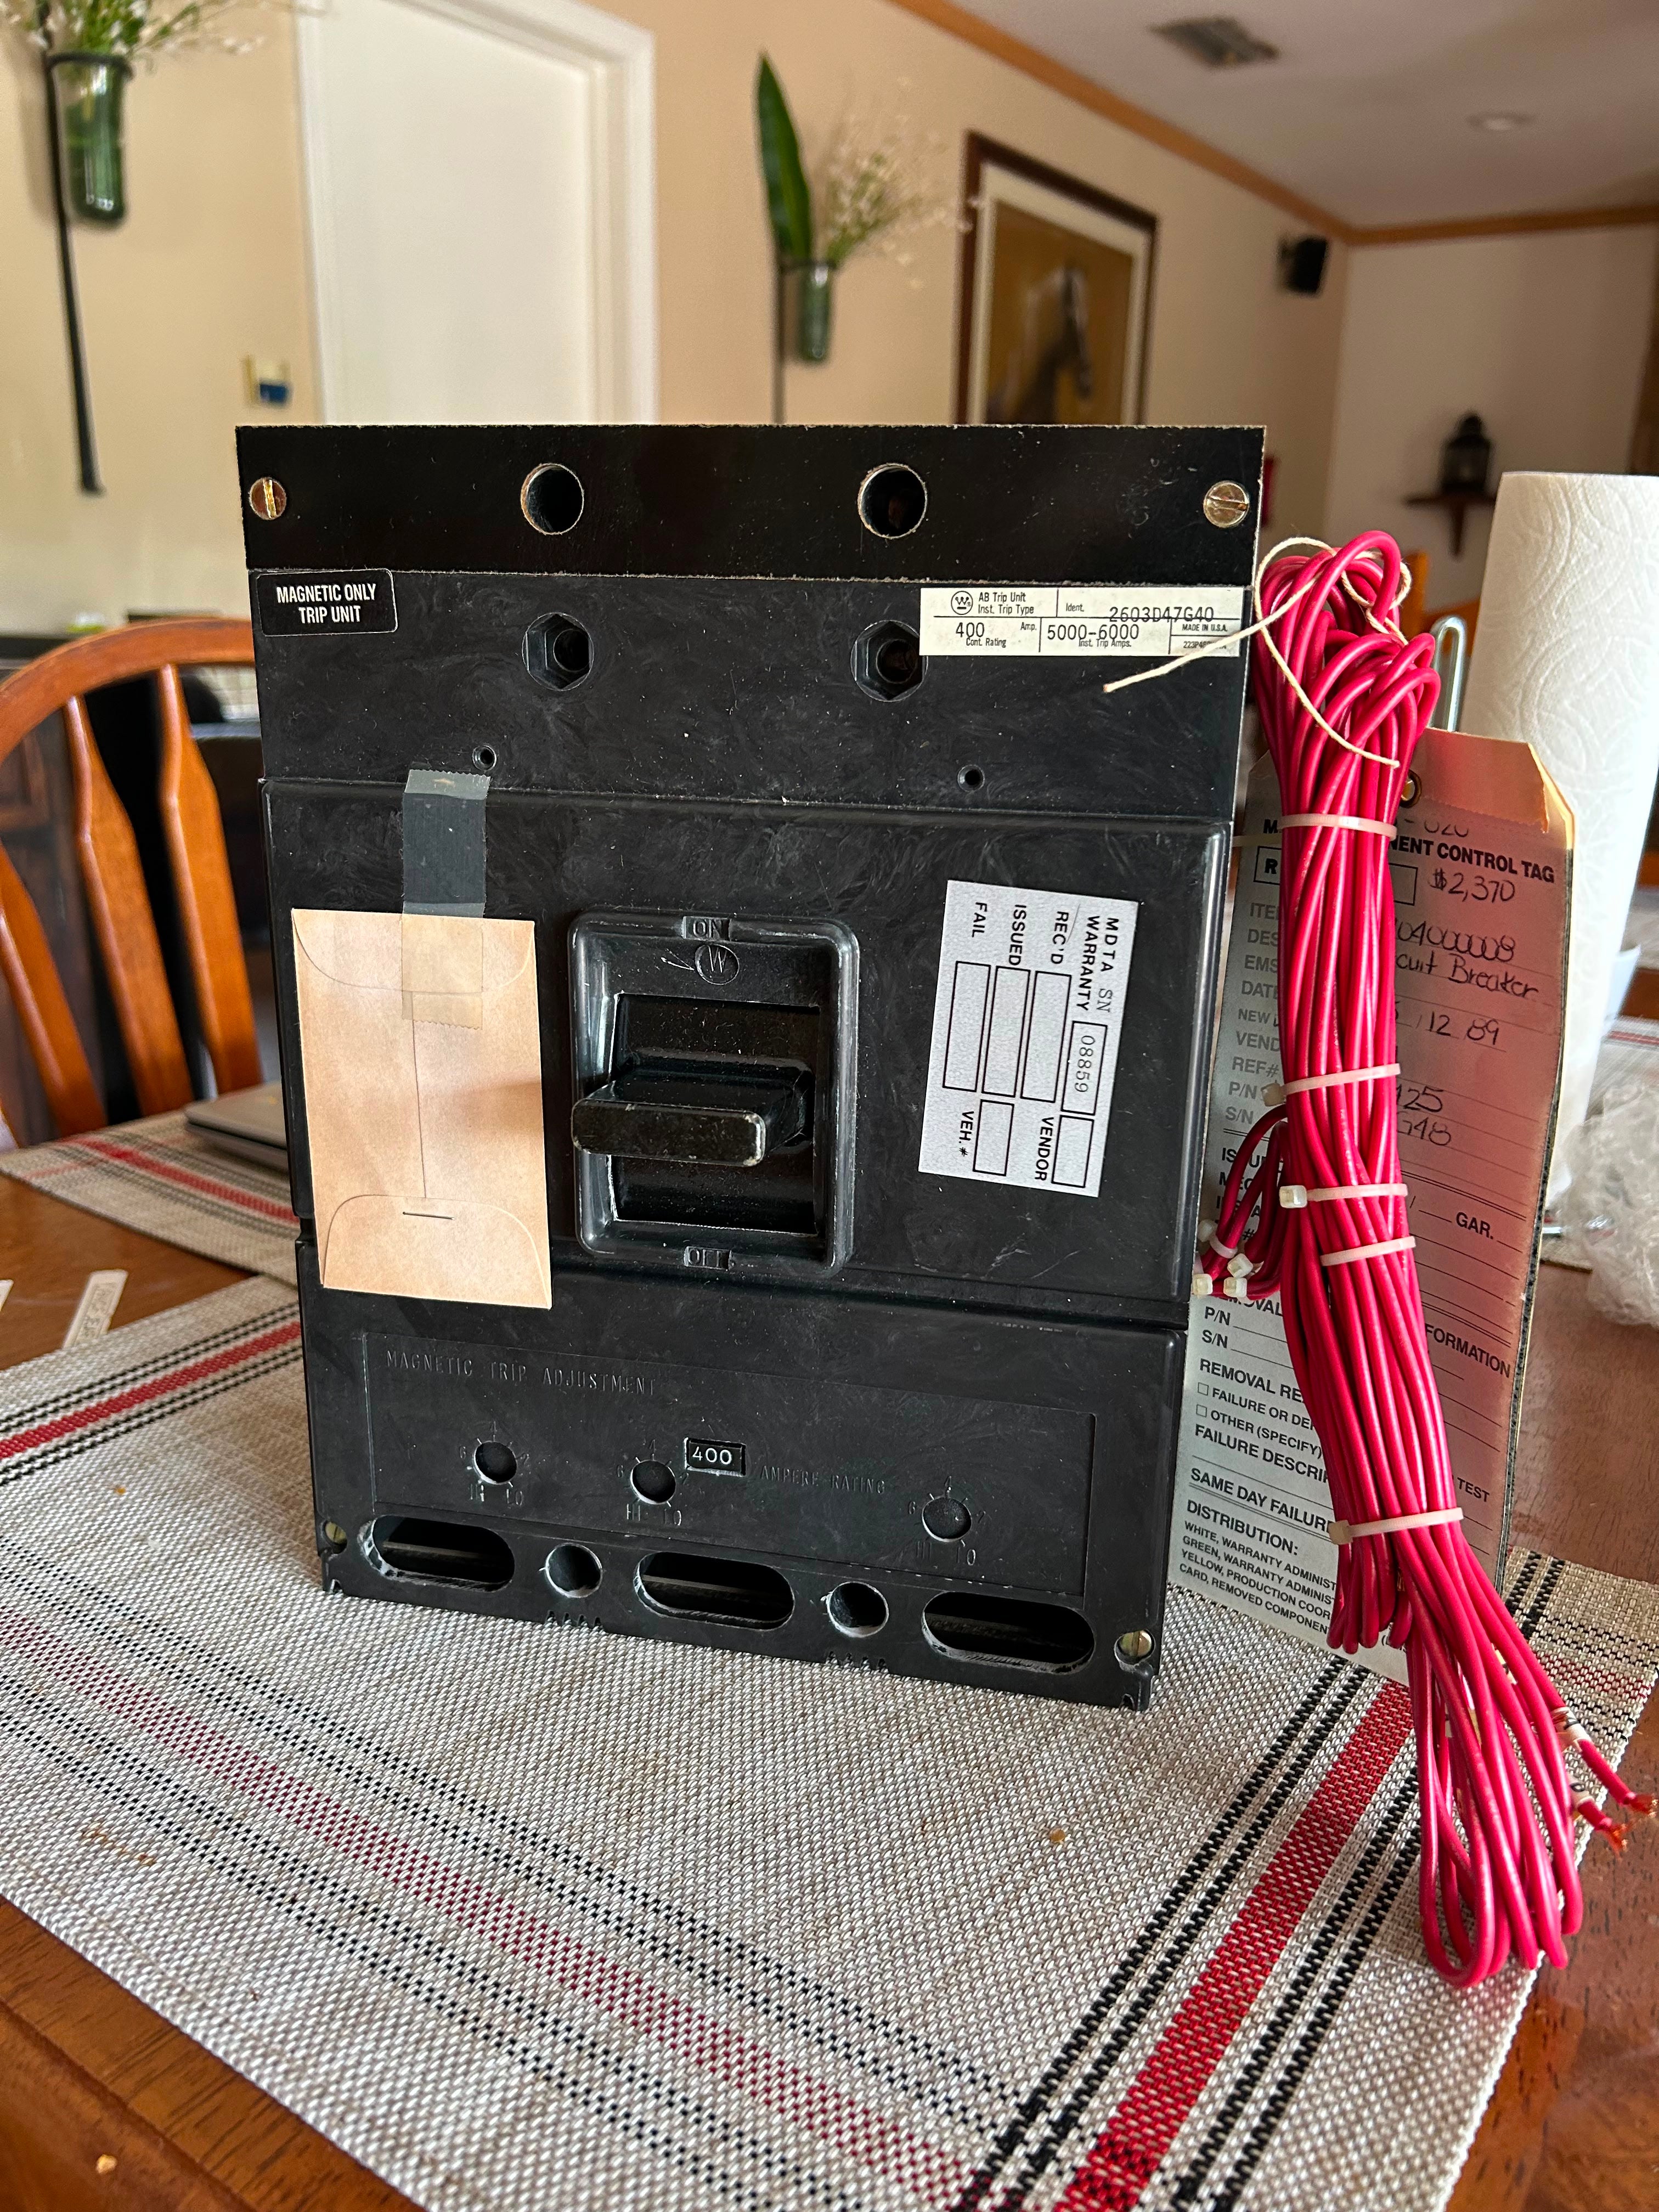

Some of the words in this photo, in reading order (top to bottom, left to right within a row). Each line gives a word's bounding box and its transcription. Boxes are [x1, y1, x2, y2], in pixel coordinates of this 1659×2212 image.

[276, 584, 341, 603] MAGNETIC
[344, 583, 376, 601] ONLY
[978, 592, 990, 602] AB
[992, 592, 1007, 604] Trip
[1010, 591, 1026, 602] Unit
[298, 606, 328, 624] TRIP
[331, 605, 361, 623] UNIT
[978, 604, 995, 614] Inst.
[998, 604, 1013, 616] Trip
[1016, 604, 1035, 616] Type
[1065, 602, 1085, 612] Ident.
[1109, 606, 1215, 623] 2603D47G40
[955, 622, 985, 637] 400
[1020, 622, 1037, 631] Amp.
[1047, 623, 1139, 641] 5000-6000
[1182, 624, 1199, 632] MADE
[1202, 624, 1209, 632] IN
[966, 637, 983, 646] Cont.
[985, 637, 1007, 648] Rating
[1079, 639, 1093, 647] Inst.
[1096, 639, 1109, 648] Trip
[1111, 639, 1132, 648] Amps.
[1436, 842, 1517, 874] CONTROL
[1521, 860, 1555, 884] TAG
[1427, 867, 1515, 904] $2,370
[693, 919, 725, 939] ON
[971, 902, 988, 938] FAIL
[1008, 905, 1027, 966] ISSUED
[1050, 911, 1069, 964] REC'D
[1076, 915, 1101, 1011] WARRANTY
[1096, 988, 1113, 1013] SN
[1238, 1008, 1271, 1025] NEW
[1074, 1035, 1096, 1093] 08859
[1231, 1056, 1279, 1078] REF#
[1228, 1081, 1257, 1101] P/N
[1224, 1106, 1254, 1125] S/N
[1034, 1116, 1054, 1182] VENDOR
[1455, 1211, 1494, 1240] GAR.
[1204, 1306, 1231, 1326] P/N
[1201, 1329, 1228, 1349] S/N
[386, 1350, 473, 1378] MAGNETIC
[490, 1361, 527, 1383] TRIP
[543, 1367, 657, 1396] ADJUSTMENT
[1200, 1358, 1276, 1395] REMOVAL
[1212, 1387, 1266, 1415] FAILURE
[1268, 1406, 1289, 1422] OR
[1195, 1423, 1260, 1458] FAILURE
[1210, 1409, 1254, 1434] OTHER
[1257, 1426, 1322, 1459] (SPECIFY)
[692, 1446, 733, 1465] 400
[760, 1465, 820, 1487] AMPERE
[831, 1474, 885, 1495] RATING
[1190, 1467, 1234, 1496] SAME
[1237, 1485, 1268, 1508] DAY
[1457, 1477, 1490, 1502] TEST
[626, 1503, 641, 1521] HI
[1187, 1499, 1299, 1556] DISTRIBUTION:
[1184, 1520, 1219, 1544] WHITE,
[1221, 1536, 1283, 1568] WARRANTY
[1182, 1536, 1221, 1561] GREEN,
[1223, 1551, 1284, 1584] WARRANTY
[1181, 1548, 1224, 1576] YELLOW,
[1227, 1568, 1296, 1606] PRODUCTION
[1298, 1599, 1331, 1621] COOR
[1180, 1563, 1210, 1585] CARD,
[1211, 1577, 1263, 1607] REMOVED
[1265, 1600, 1329, 1635] COMPONEN
